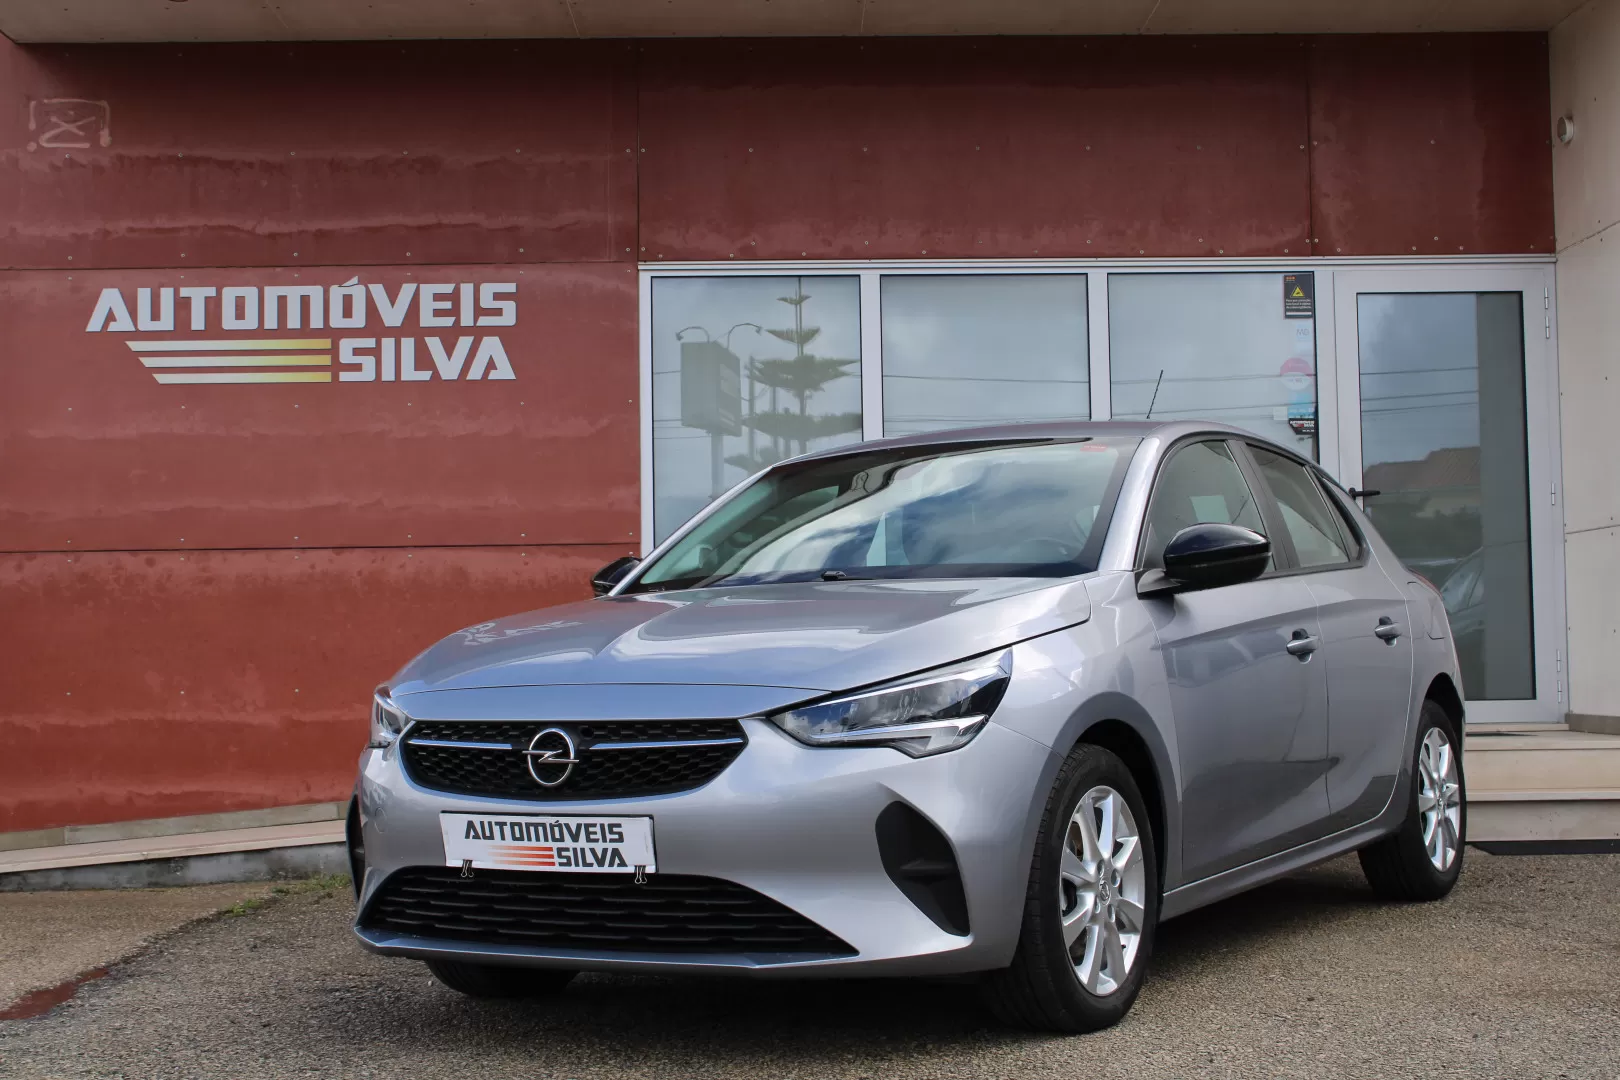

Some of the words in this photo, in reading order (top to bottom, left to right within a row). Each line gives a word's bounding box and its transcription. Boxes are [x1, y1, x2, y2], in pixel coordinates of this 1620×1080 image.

[85, 275, 517, 332] AUTOMÓVEIS
[338, 335, 517, 381] SILVA
[464, 820, 625, 844] AUTOMÓVEIS
[556, 846, 629, 868] SILVA
